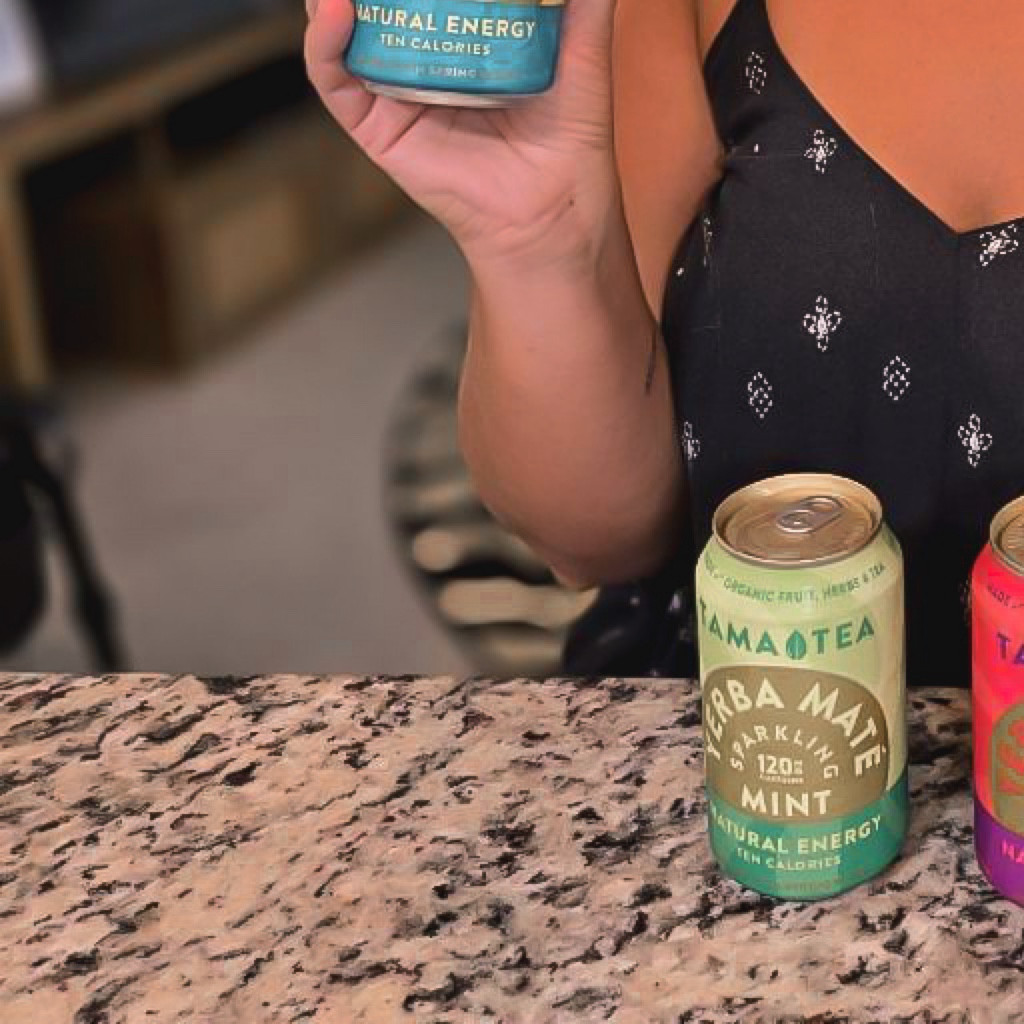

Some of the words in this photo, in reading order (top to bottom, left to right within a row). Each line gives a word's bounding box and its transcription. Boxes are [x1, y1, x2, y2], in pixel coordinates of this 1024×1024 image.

[356, 3, 438, 32] NATURAL
[446, 15, 536, 39] ENERGY
[380, 33, 405, 48] TEN
[410, 37, 491, 56] CALORIES
[699, 596, 779, 657] TAMA
[811, 614, 875, 655] TEA
[704, 677, 785, 761] YERBA
[797, 681, 887, 776] MATÉ
[729, 724, 839, 780] SPARKLING
[741, 783, 832, 818] MINT
[711, 806, 789, 854] NATURAL
[797, 814, 882, 855] ENERGY
[737, 847, 761, 865] TEN
[766, 855, 842, 872] CALORIES
